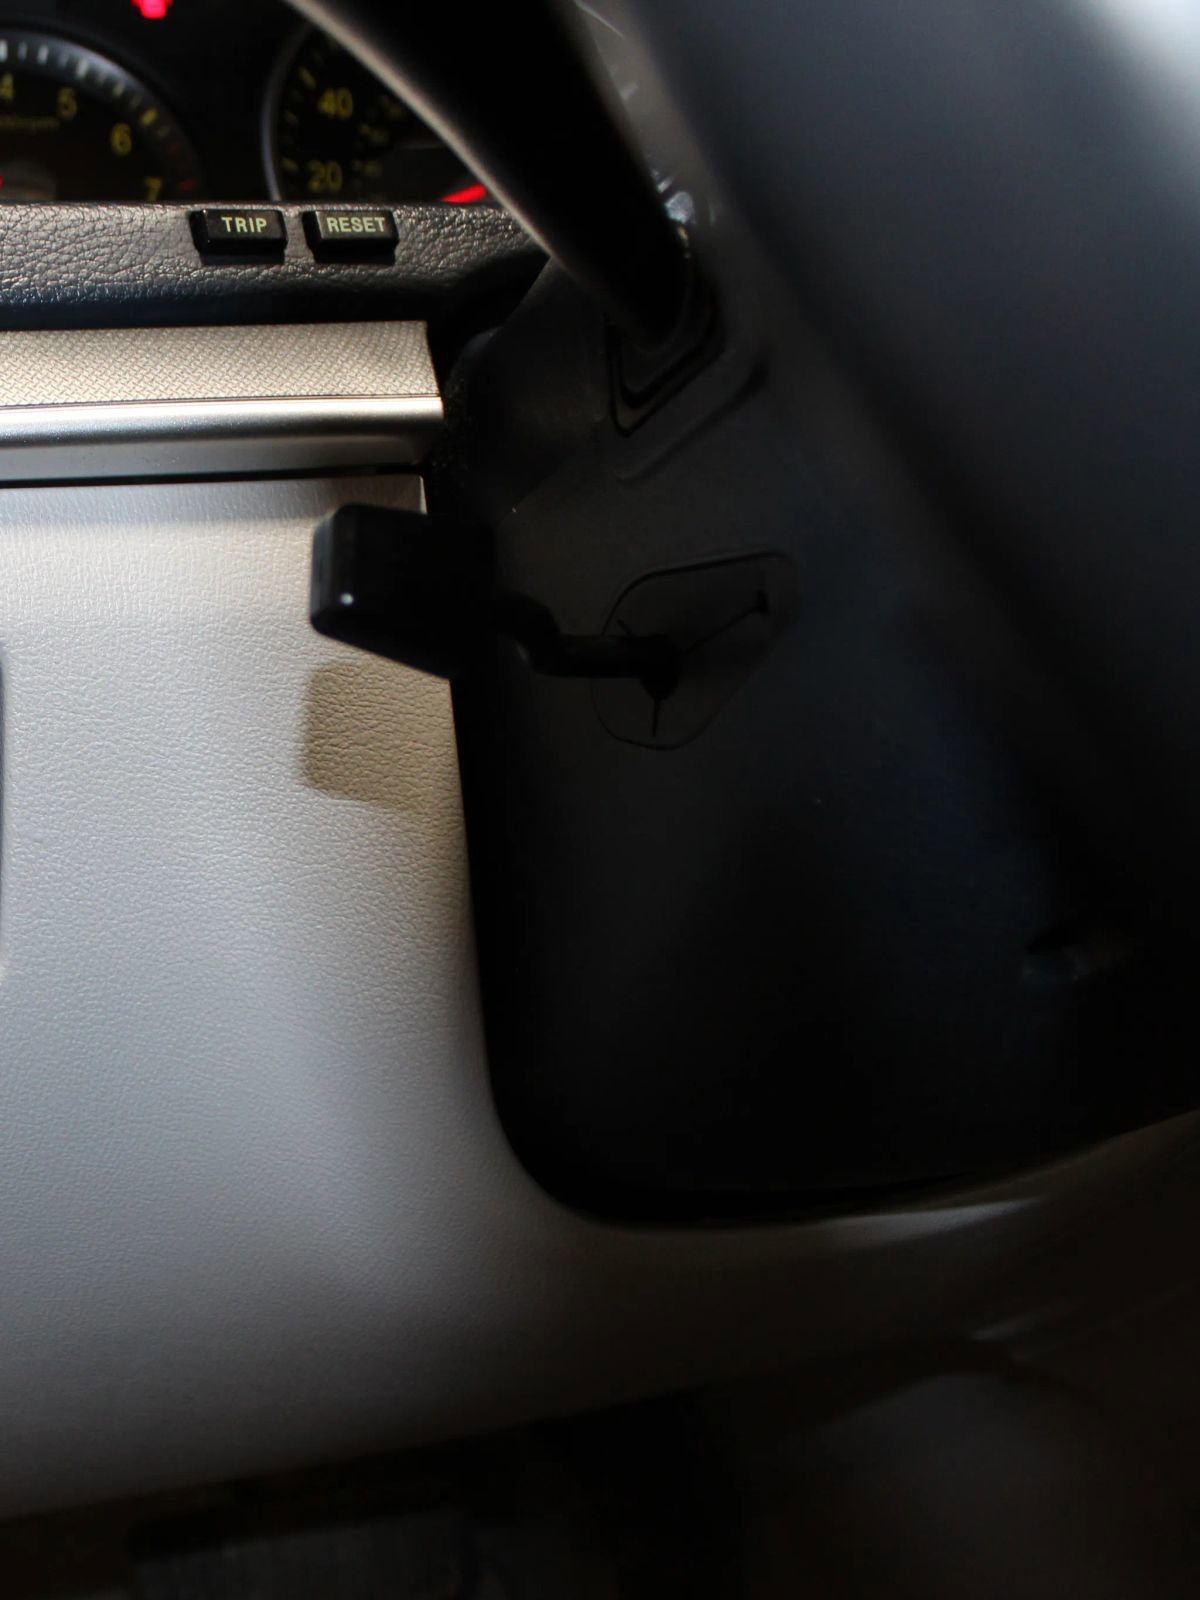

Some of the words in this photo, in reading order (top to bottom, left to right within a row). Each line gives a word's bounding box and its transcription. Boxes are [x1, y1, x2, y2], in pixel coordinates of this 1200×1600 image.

[316, 87, 354, 120] 40
[109, 122, 132, 156] 6
[307, 160, 344, 192] 20
[220, 216, 268, 234] TRIP
[325, 216, 386, 234] RESET
